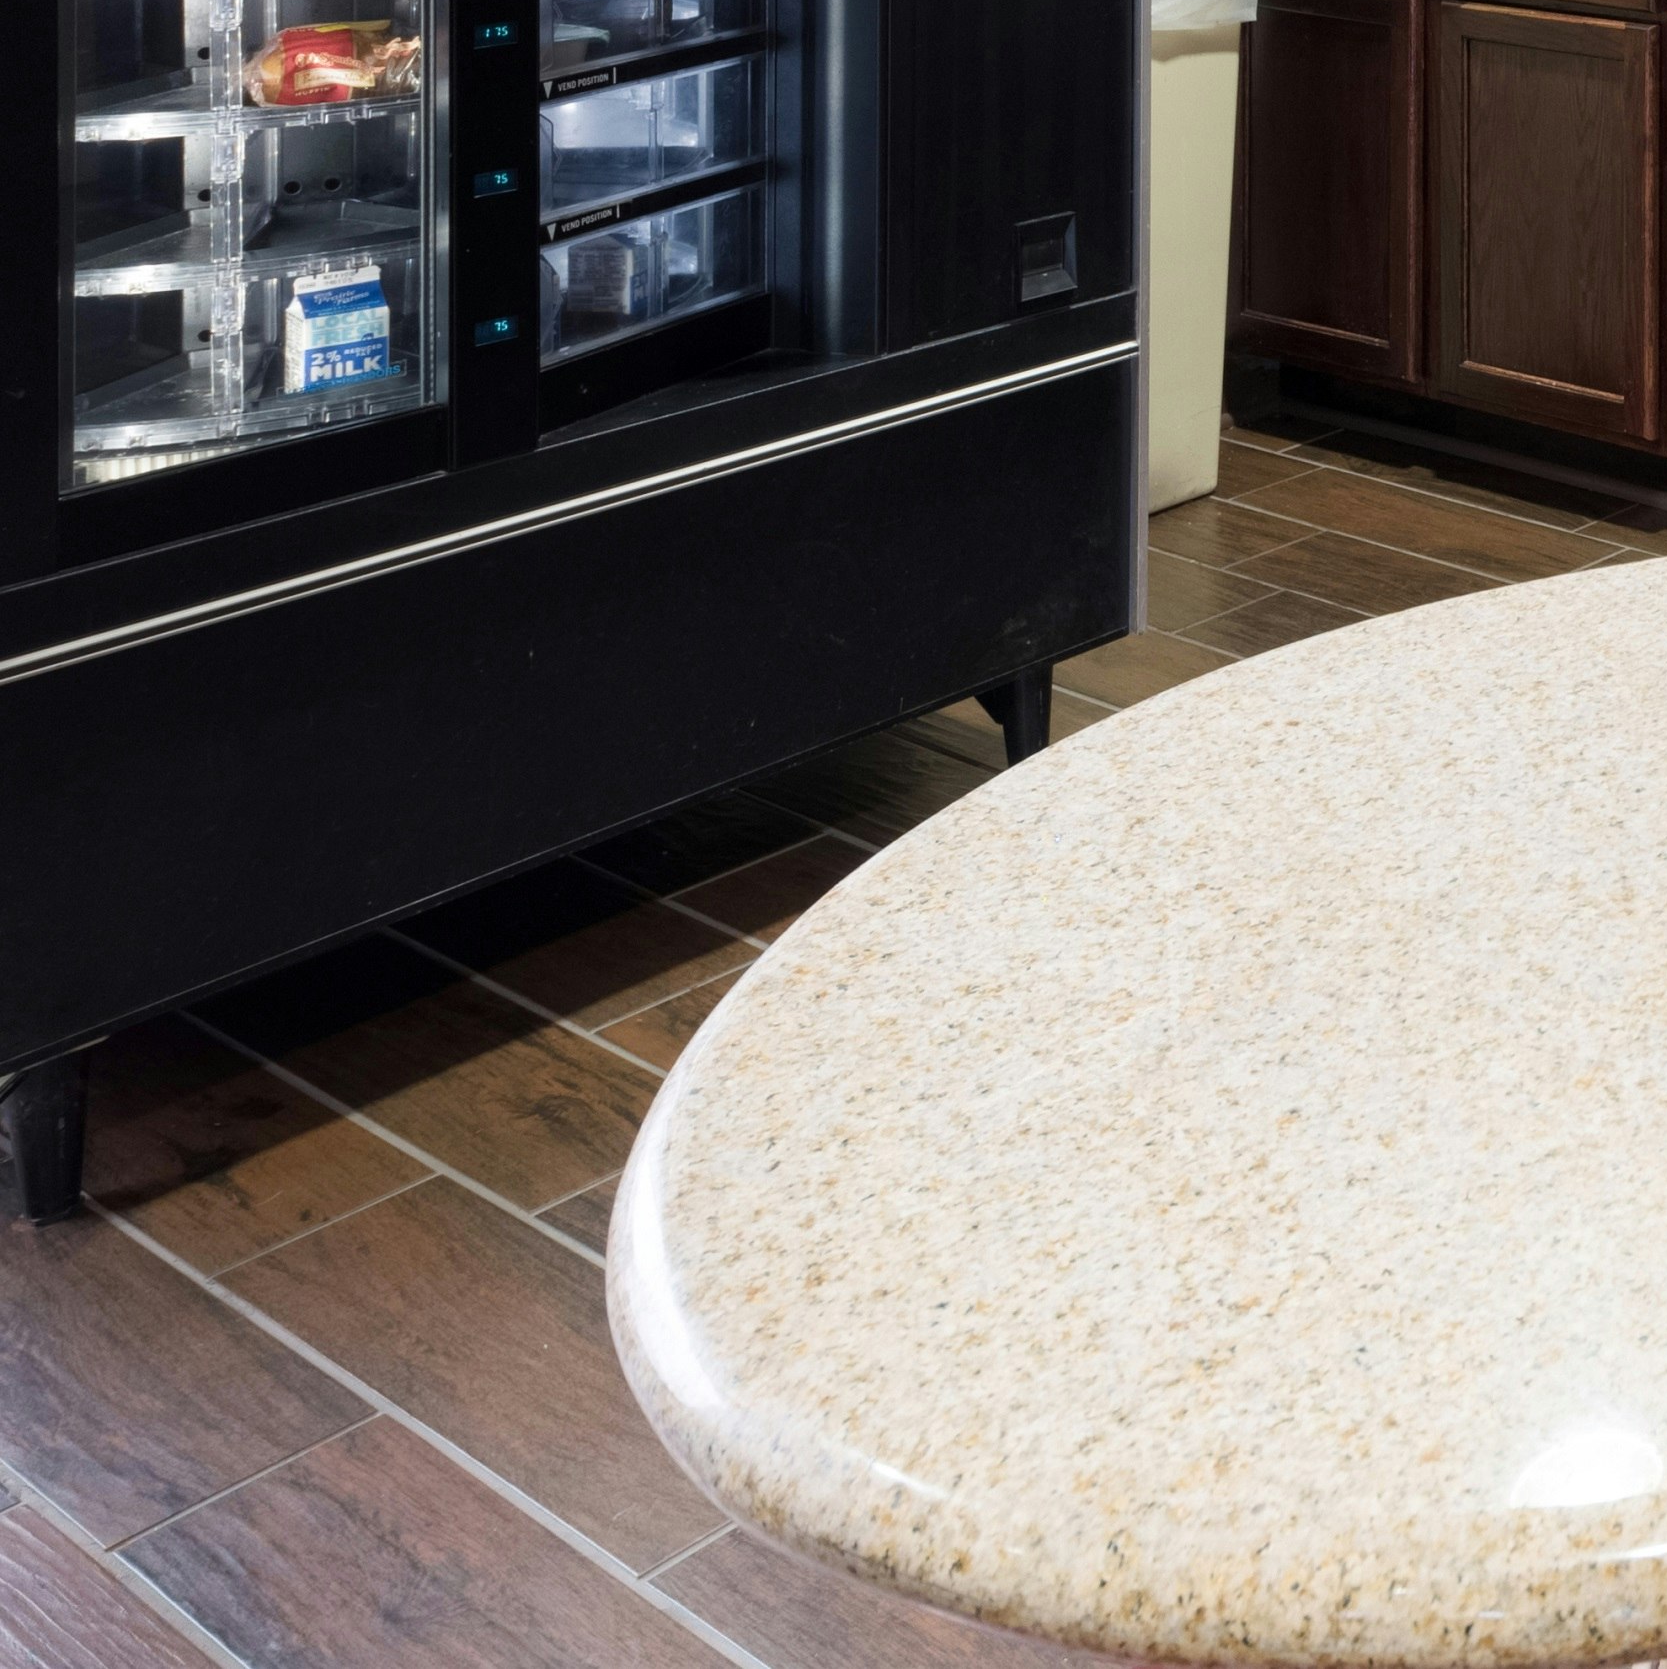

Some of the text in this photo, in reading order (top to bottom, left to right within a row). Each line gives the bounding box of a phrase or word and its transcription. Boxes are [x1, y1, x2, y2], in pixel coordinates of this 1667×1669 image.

[558, 73, 609, 92] VEND POSITION
[561, 209, 612, 232] VEND POSITION
[494, 319, 509, 332] 75
[310, 350, 342, 366] 2%
[310, 355, 383, 383] MILK
